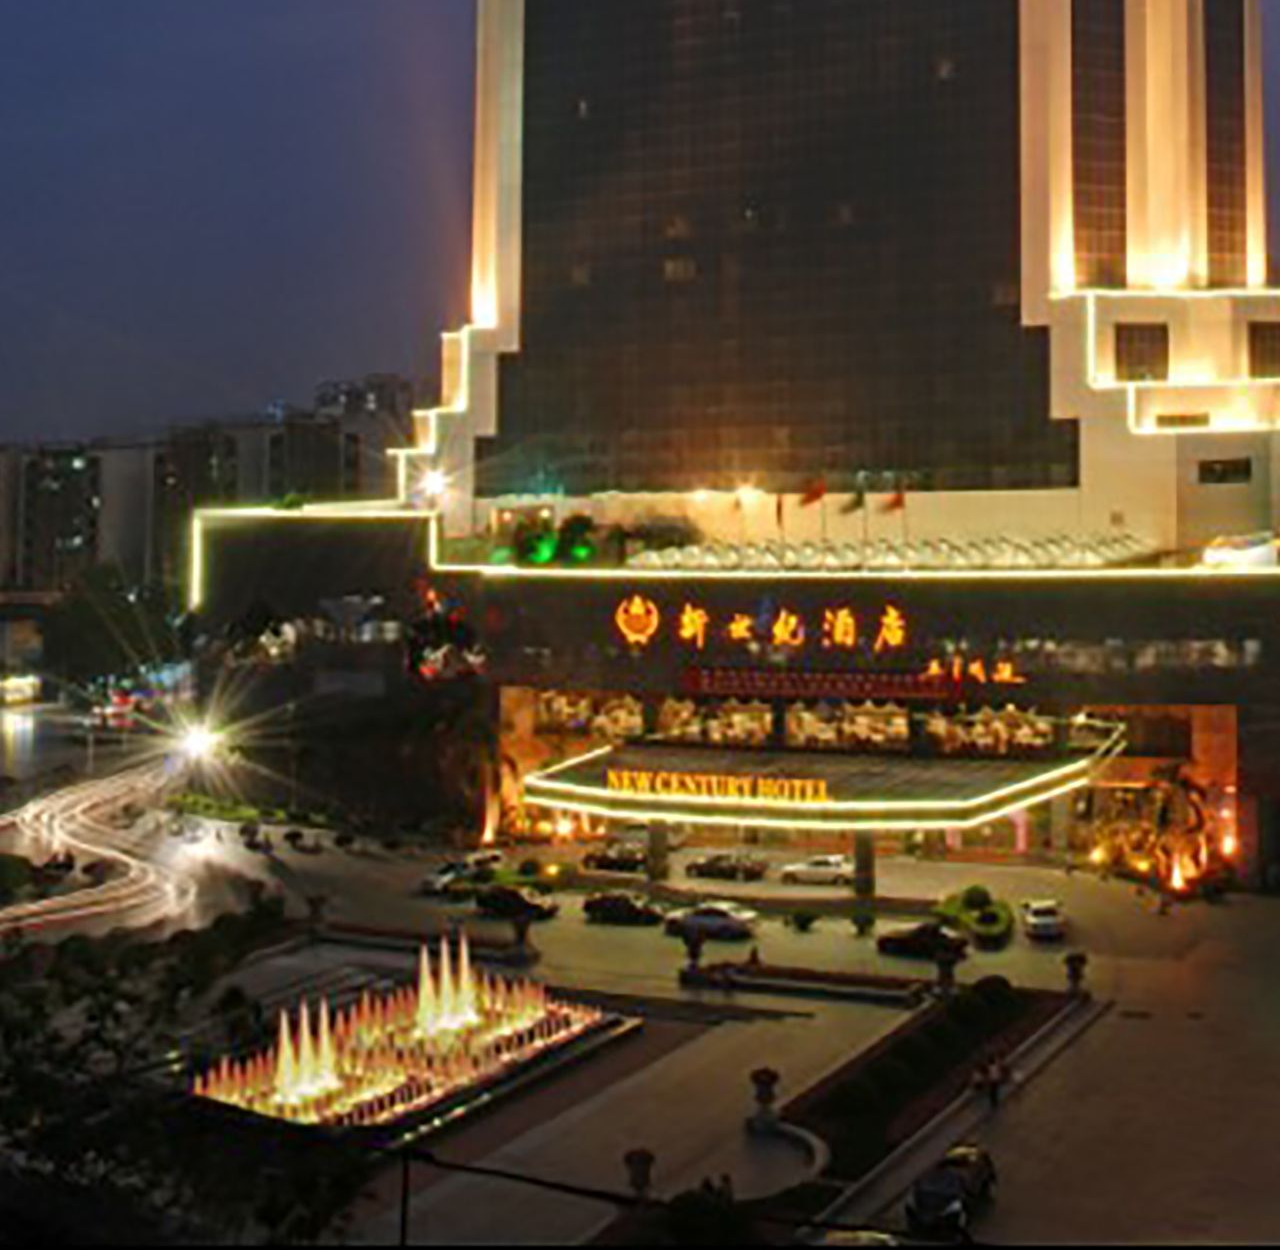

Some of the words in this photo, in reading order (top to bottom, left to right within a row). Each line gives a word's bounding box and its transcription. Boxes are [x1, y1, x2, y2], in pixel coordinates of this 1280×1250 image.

[606, 768, 653, 794] NEW
[655, 771, 754, 799] CENTURY
[757, 777, 830, 803] HOTEL
